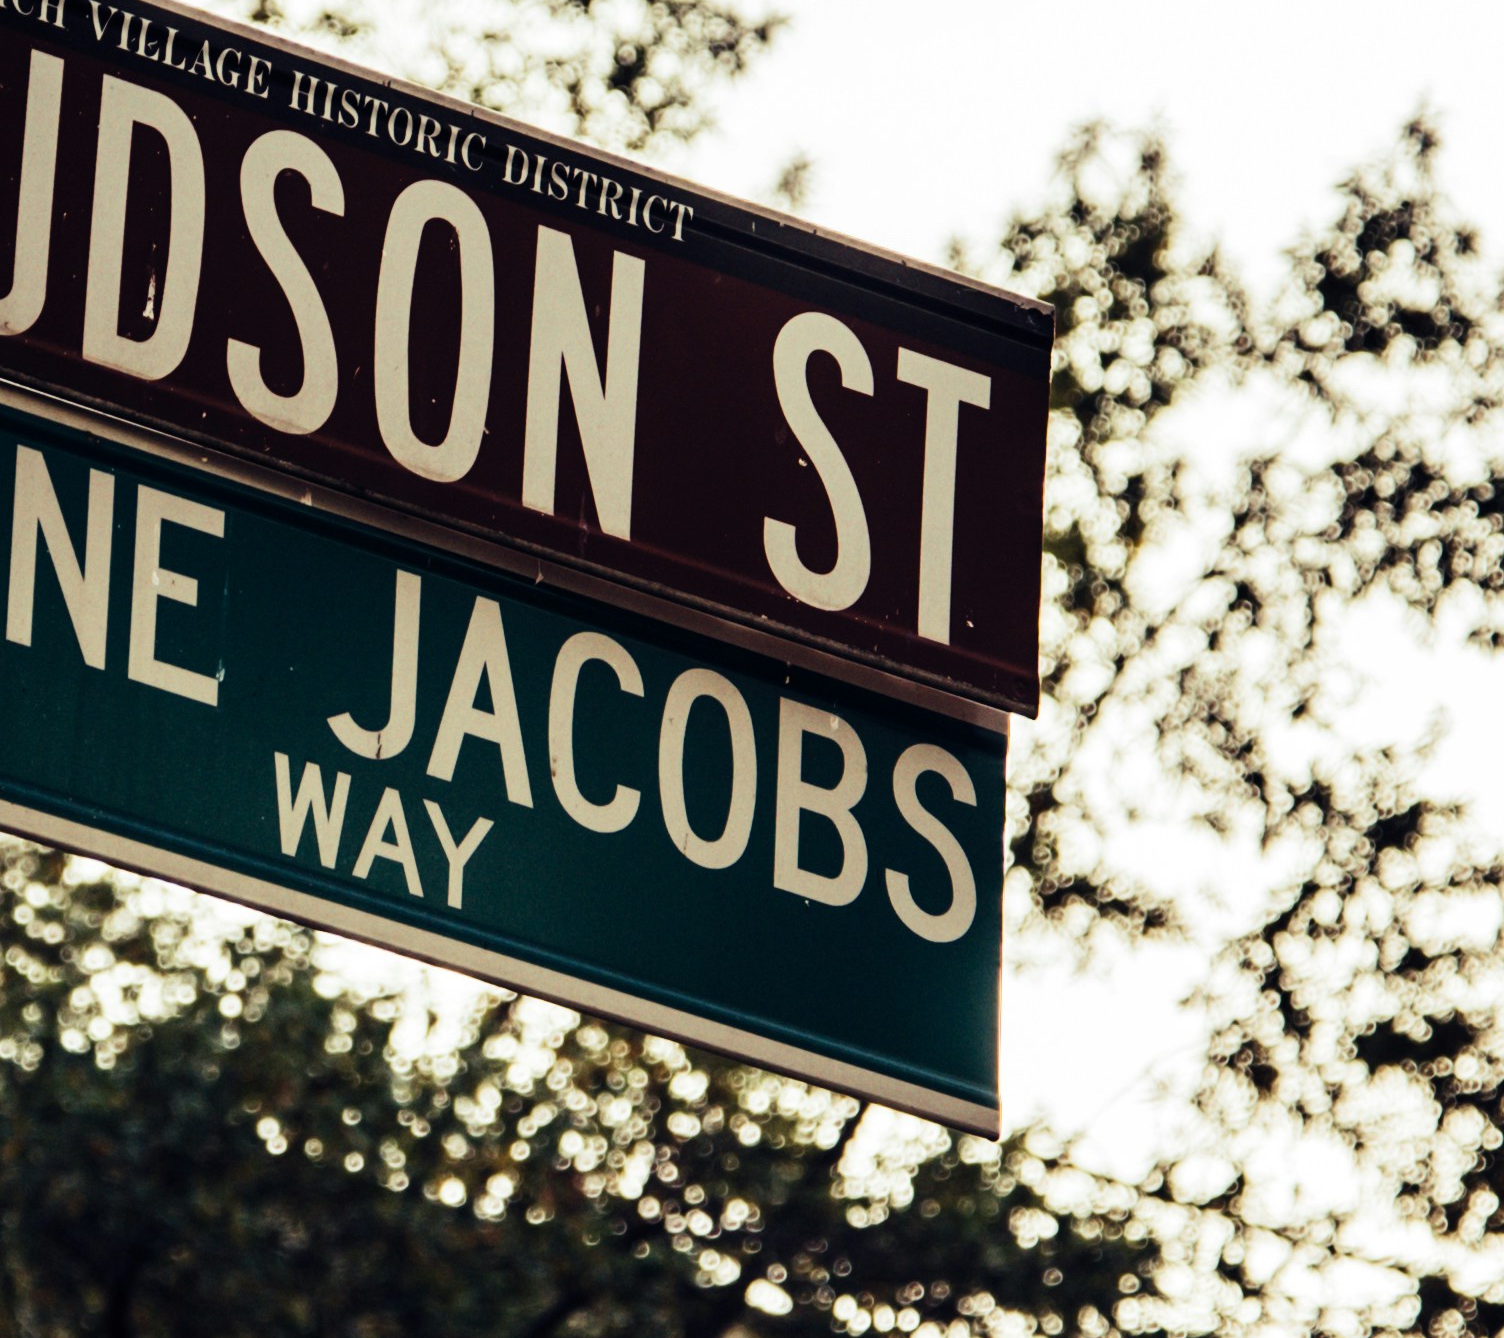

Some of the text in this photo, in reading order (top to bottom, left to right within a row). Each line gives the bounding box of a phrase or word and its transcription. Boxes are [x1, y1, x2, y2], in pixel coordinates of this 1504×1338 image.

[88, 0, 272, 99] VILLAGE
[289, 70, 487, 171] HISTORIC
[503, 144, 694, 242] DISTRICT
[763, 311, 992, 646] ST
[274, 752, 494, 910] WAY
[326, 568, 978, 943] JACOBS
